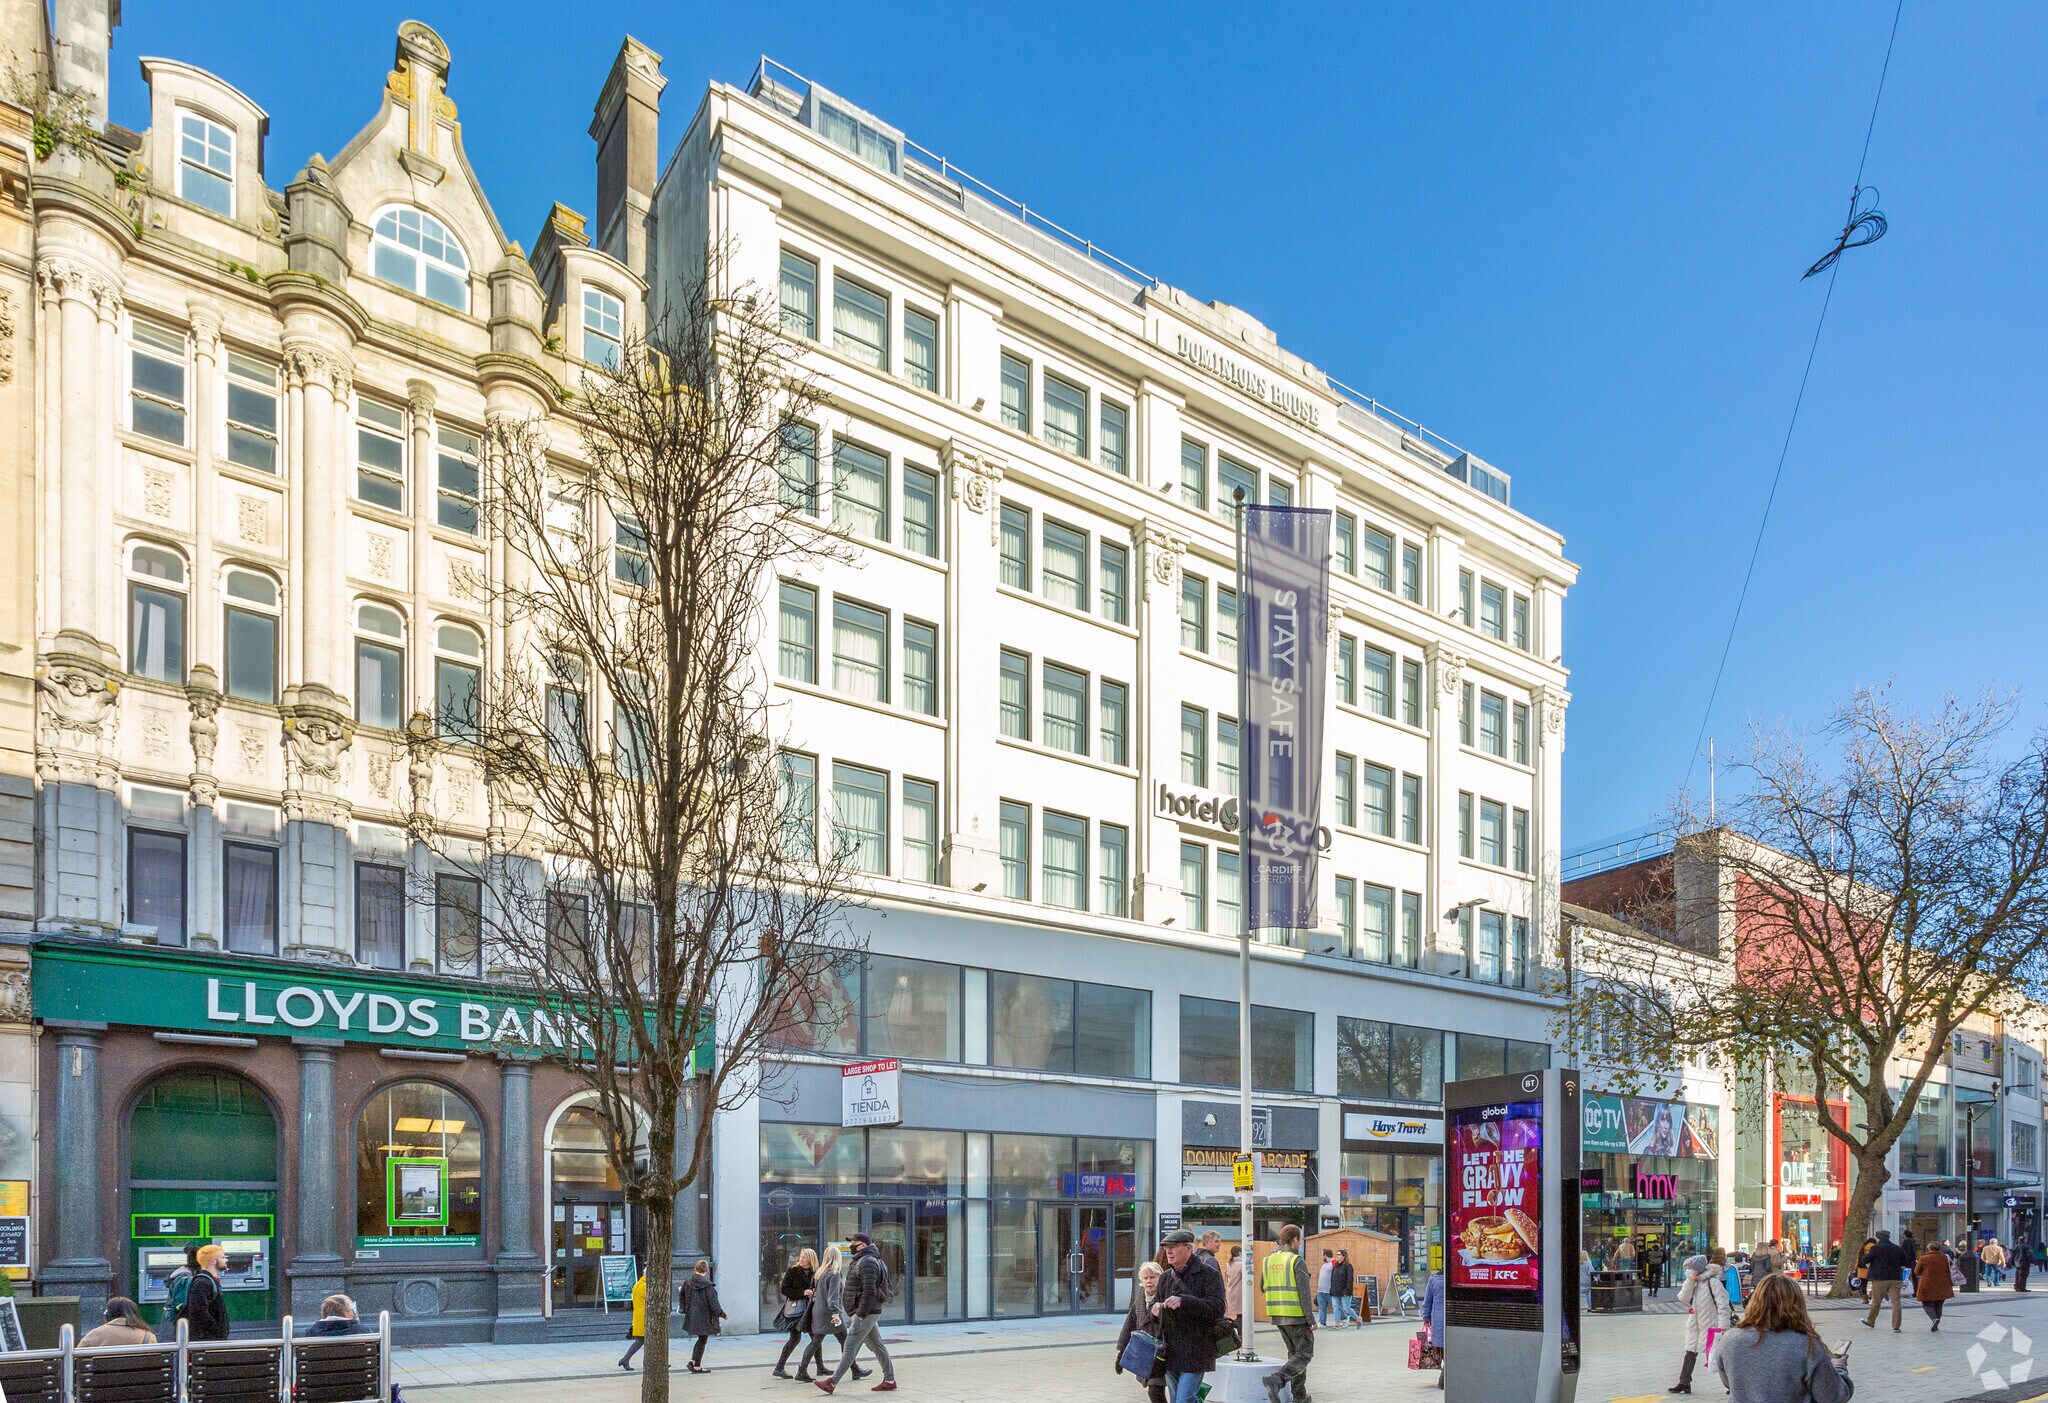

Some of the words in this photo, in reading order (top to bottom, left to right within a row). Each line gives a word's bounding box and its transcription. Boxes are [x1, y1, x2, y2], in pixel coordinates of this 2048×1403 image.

[1177, 333, 1266, 399] DOMINIONS
[1270, 384, 1320, 427] HOUSE
[1272, 589, 1298, 667] STAY
[1269, 676, 1295, 758] SAFE
[1160, 783, 1219, 824] hotel
[1257, 865, 1302, 875] CARDIFF
[1252, 874, 1306, 884] CAERDYDD
[207, 978, 439, 1038] LLOYDS
[460, 1003, 599, 1051] BANK
[844, 1067, 862, 1076] LARGE
[862, 1064, 877, 1074] SHOP
[878, 1063, 886, 1071] TO
[886, 1061, 897, 1070] LET
[1525, 1079, 1536, 1088] BT
[851, 1100, 889, 1113] TIENDA
[1482, 1105, 1508, 1120] global
[1372, 1119, 1396, 1135] Hays
[1396, 1121, 1428, 1135] Travel
[1584, 1108, 1602, 1128] DC
[1604, 1109, 1621, 1130] TV
[1186, 1150, 1234, 1167] DOMINI
[1260, 1154, 1308, 1169] ARCADE
[1463, 1152, 1490, 1166] LET
[1493, 1149, 1525, 1163] THE
[1463, 1163, 1524, 1190] GRAVY
[1582, 1177, 1601, 1187] hmv
[1637, 1162, 1679, 1200] hmv
[1463, 1188, 1525, 1208] FLOW
[1395, 1275, 1401, 1285] 3
[1494, 1270, 1519, 1280] KFC
